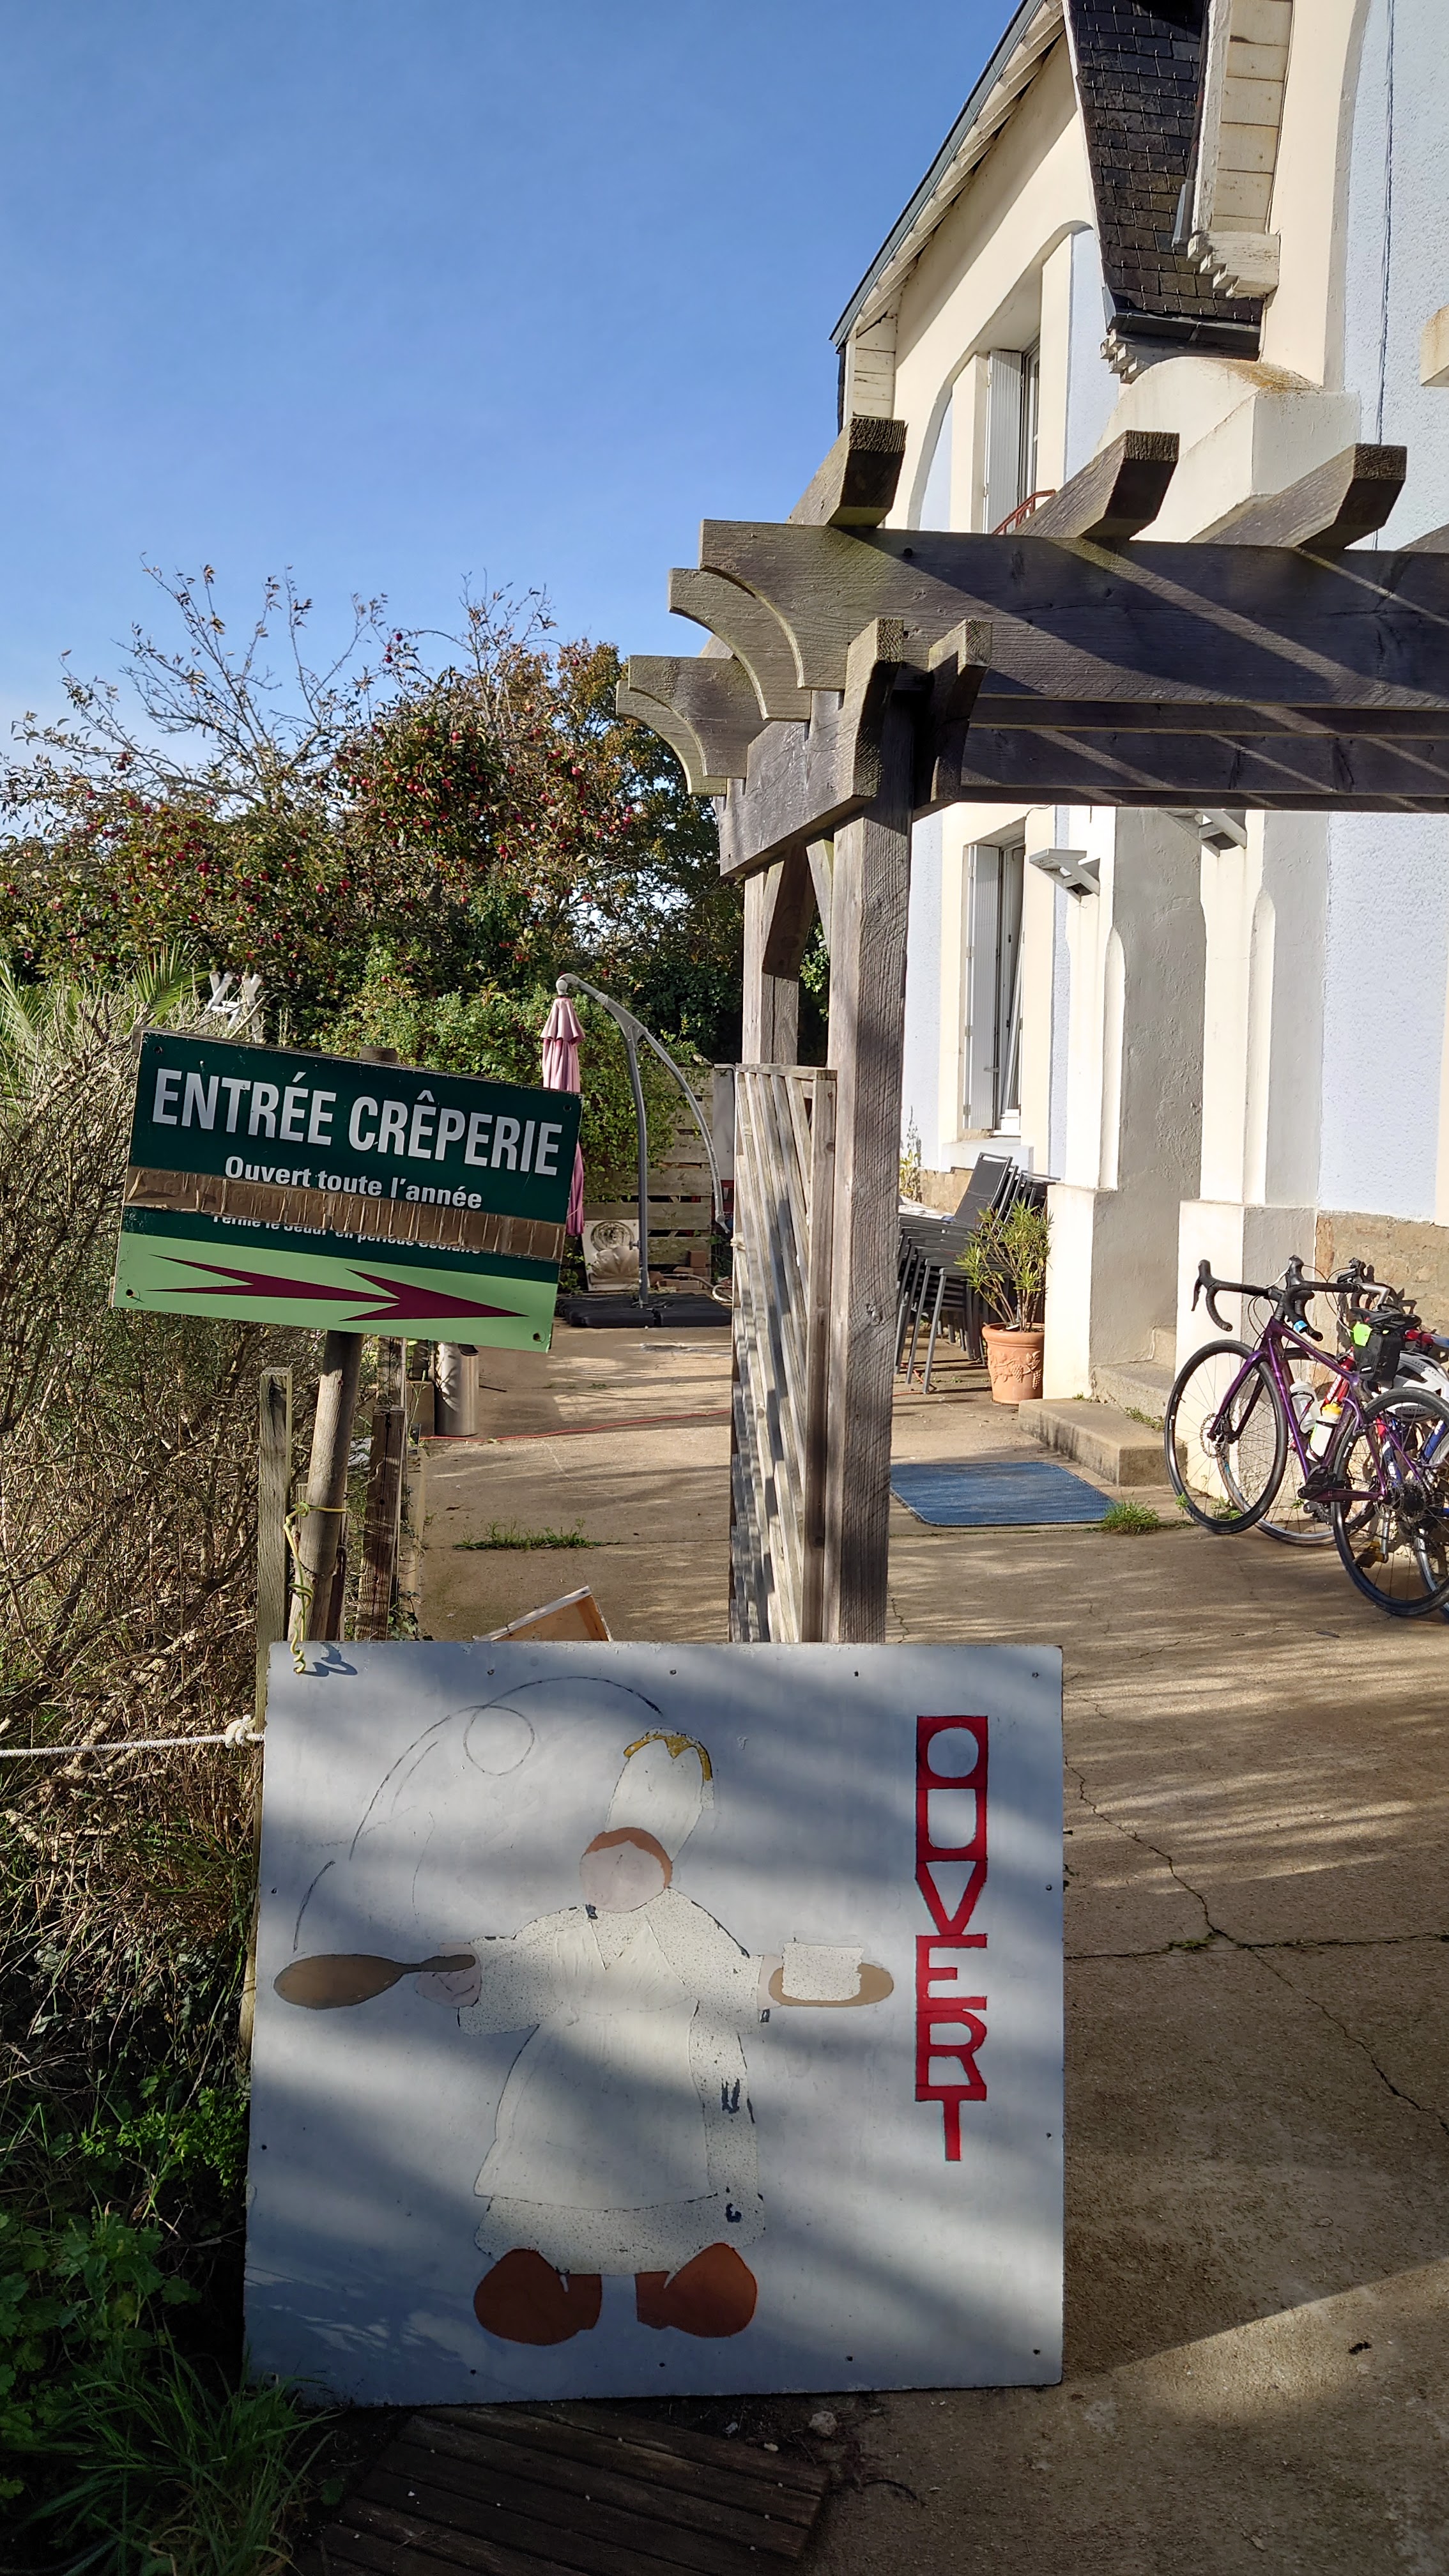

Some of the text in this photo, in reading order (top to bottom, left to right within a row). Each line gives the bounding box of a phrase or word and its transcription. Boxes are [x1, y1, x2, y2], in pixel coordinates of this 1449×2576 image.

[152, 1068, 563, 1176] ENTRÉE CRÊPERIE
[224, 1156, 311, 1186] Ouvert
[318, 1169, 383, 1197] toute
[390, 1176, 482, 1209] l'année
[915, 1715, 988, 2161] OUVERT
